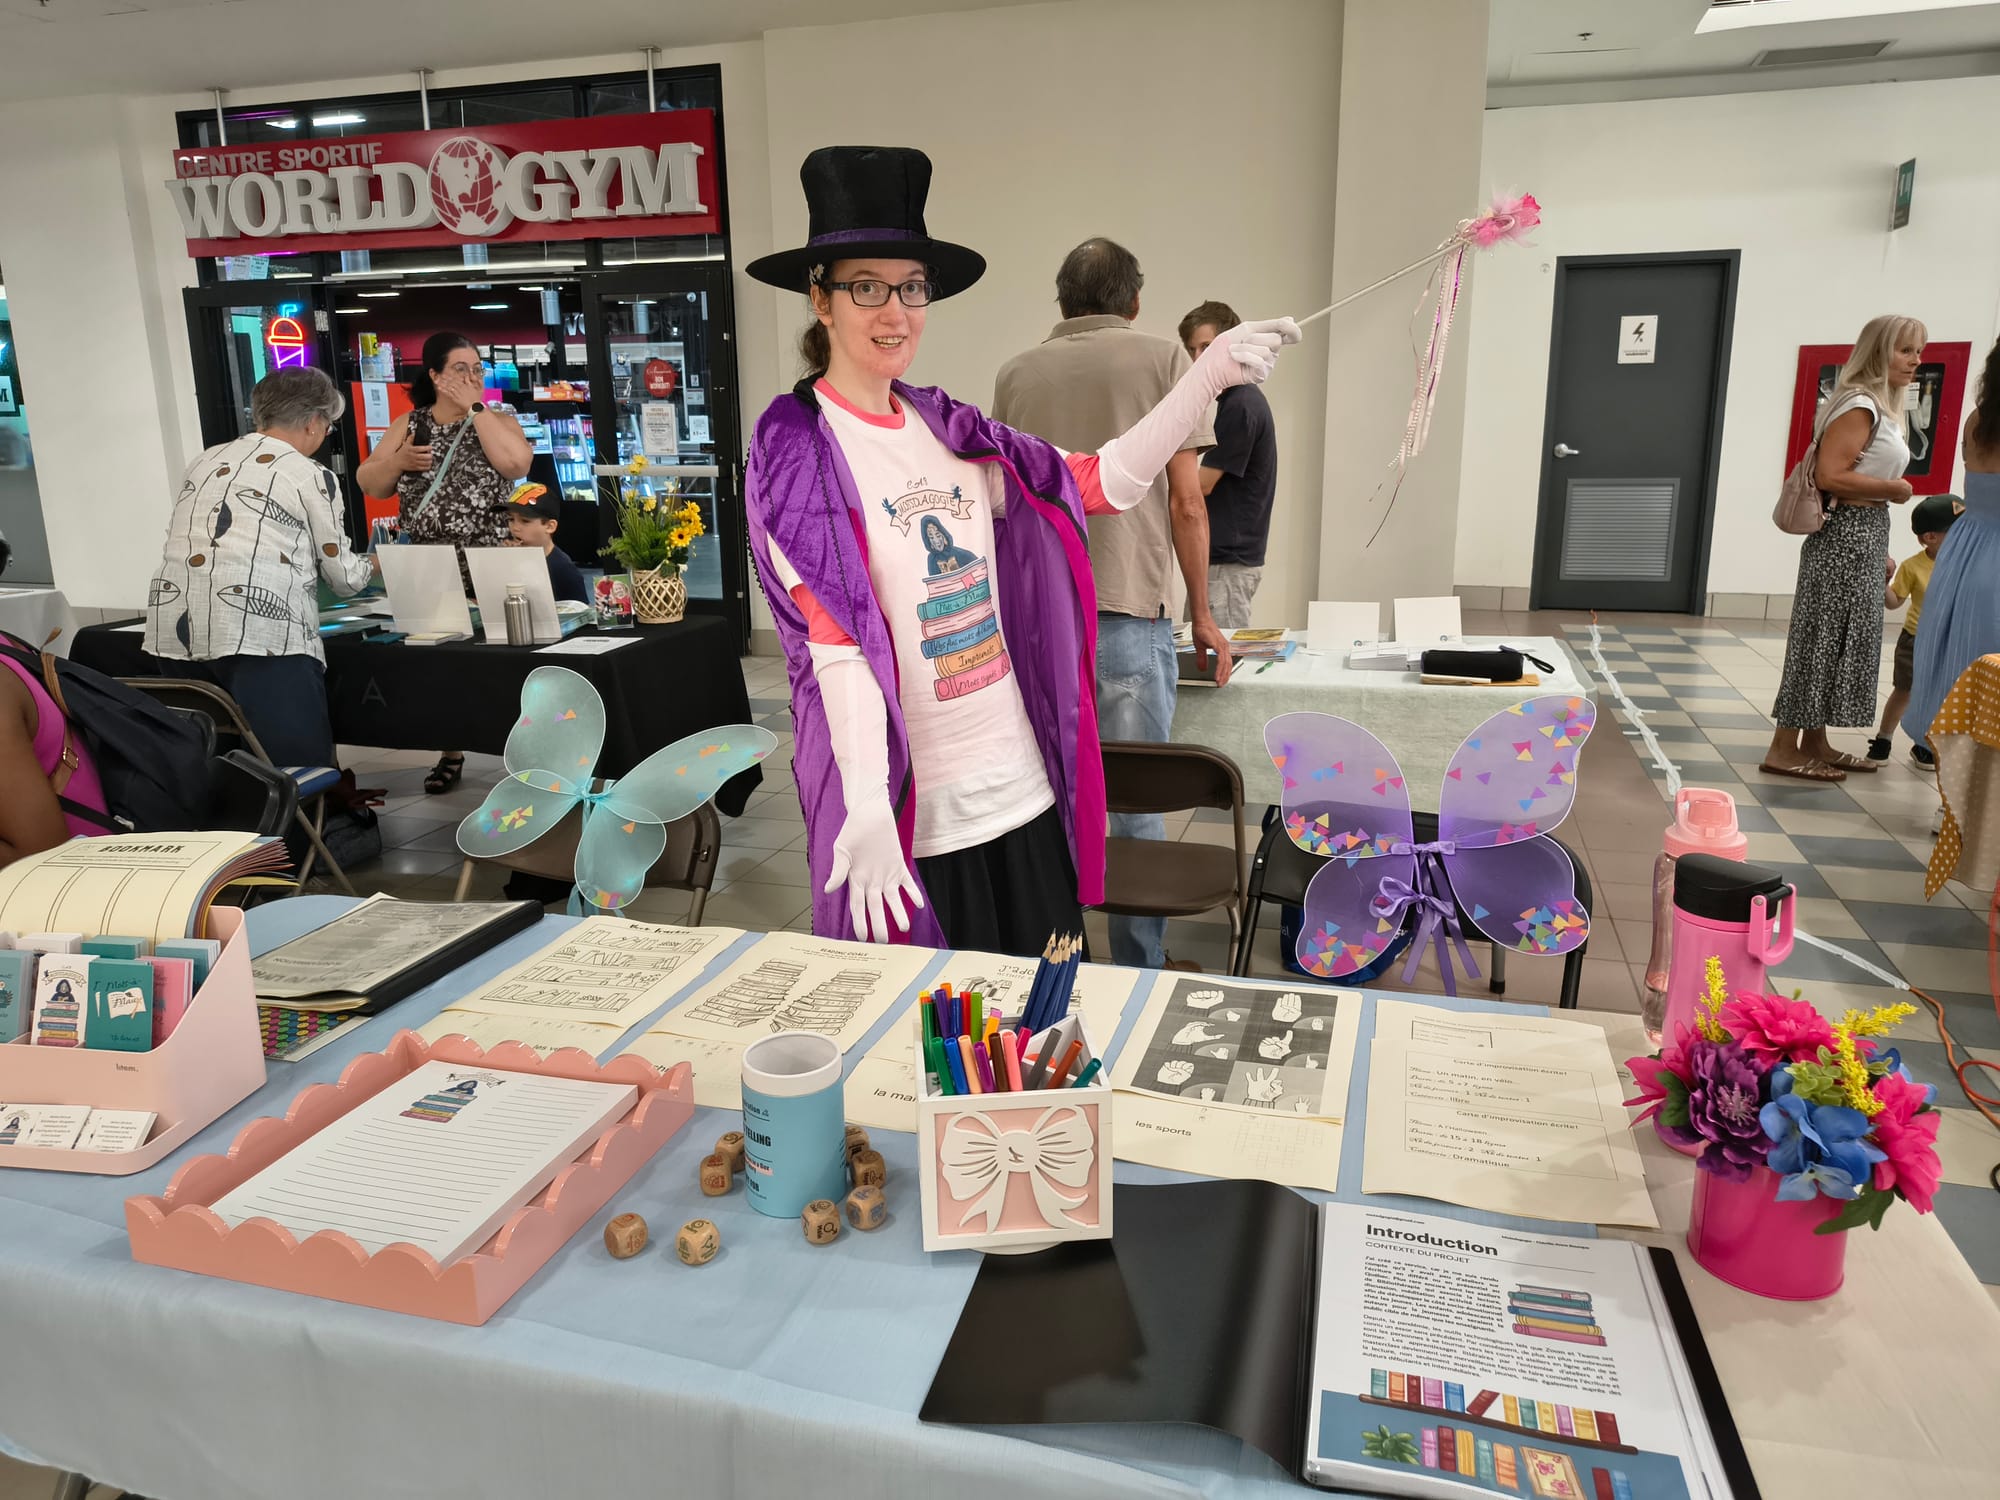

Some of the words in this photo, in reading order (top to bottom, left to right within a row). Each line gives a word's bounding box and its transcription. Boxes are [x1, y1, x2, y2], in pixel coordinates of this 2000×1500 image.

[177, 151, 273, 178] CENTRE
[278, 142, 383, 170] SPORTIF
[165, 163, 436, 239] WORLD
[504, 142, 708, 222] GYM
[98, 845, 184, 853] BOOKMARK
[1454, 1058, 1474, 1067] Carte
[874, 1088, 889, 1097] la
[1457, 1110, 1479, 1118] Carte
[1482, 1113, 1548, 1128] d'improvisation
[1136, 1121, 1152, 1130] les
[1156, 1125, 1192, 1137] sports
[1453, 1153, 1510, 1169] Dramatique
[1367, 1224, 1498, 1256] Introduction
[1366, 1241, 1415, 1254] CONTEXTE
[1434, 1253, 1470, 1263] PROJET
